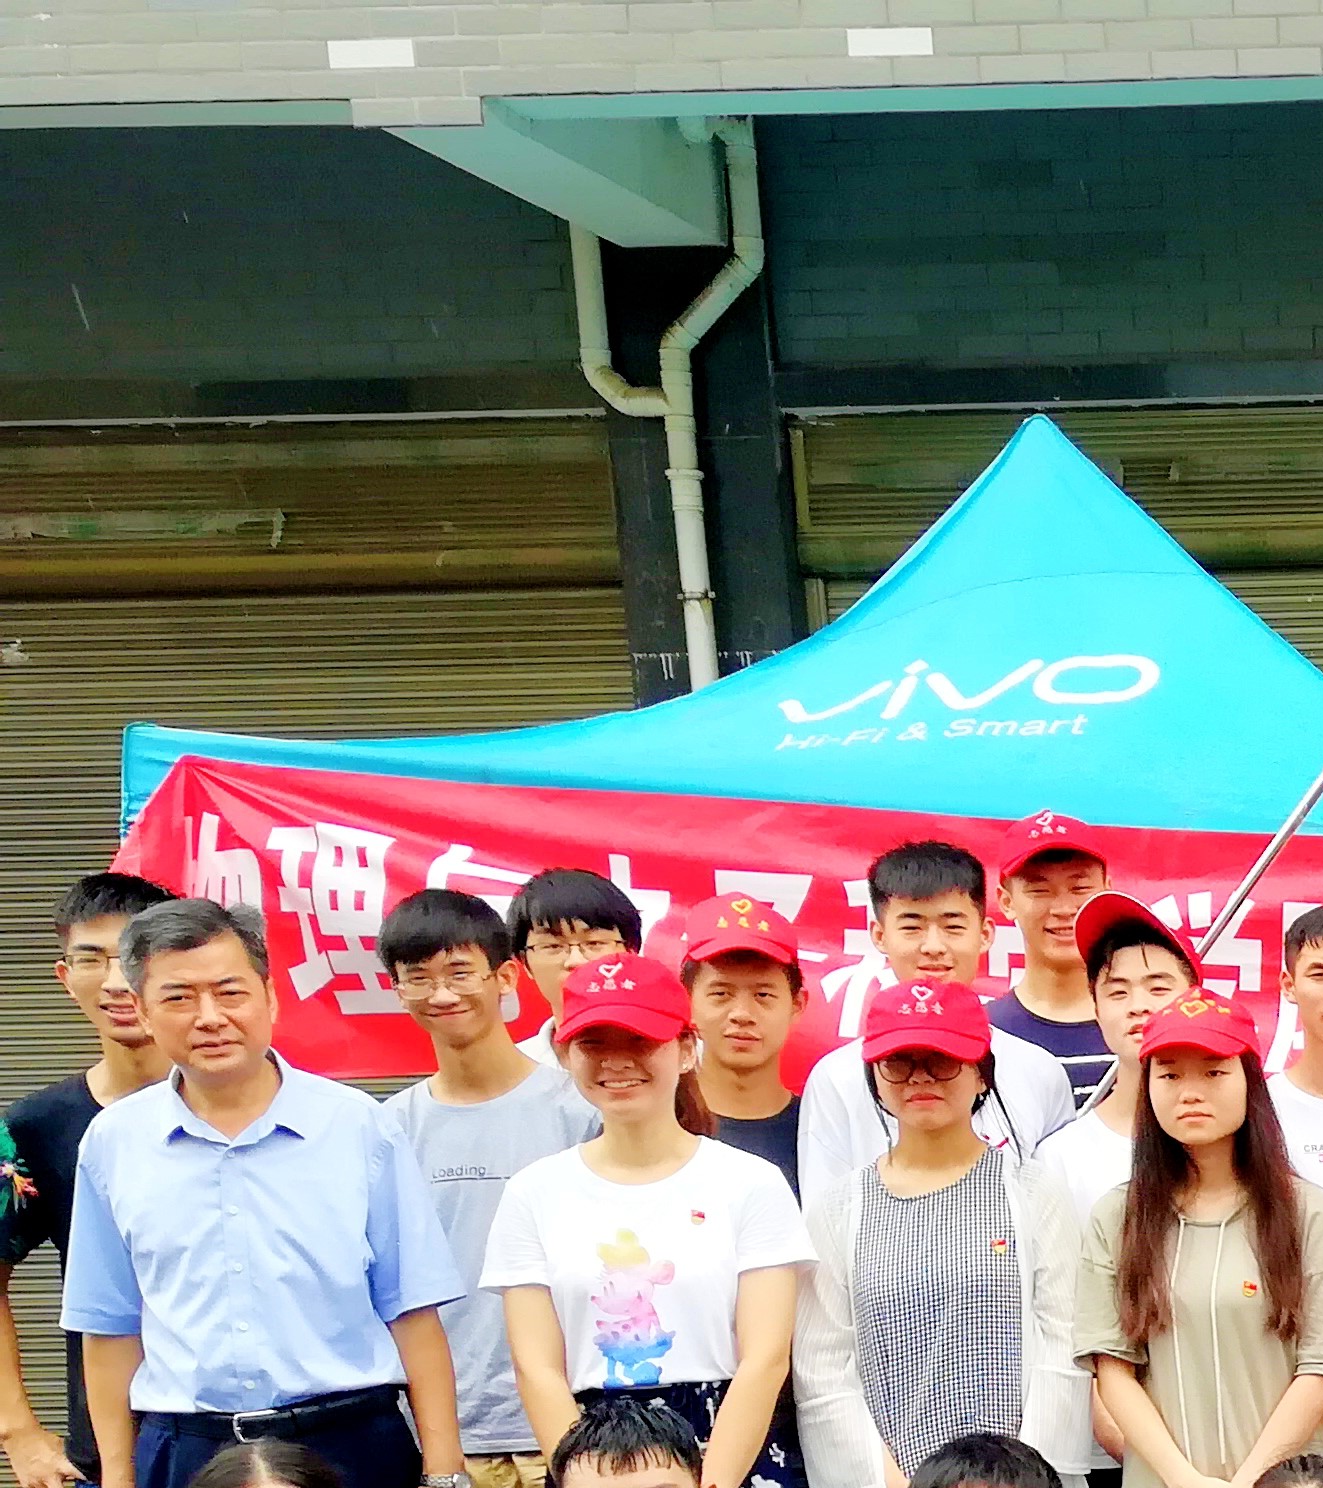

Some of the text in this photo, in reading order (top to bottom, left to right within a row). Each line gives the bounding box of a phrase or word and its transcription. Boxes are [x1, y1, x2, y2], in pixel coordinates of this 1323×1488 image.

[777, 654, 1161, 723] vivo
[775, 713, 1089, 752] Hi-Fi & Smart
